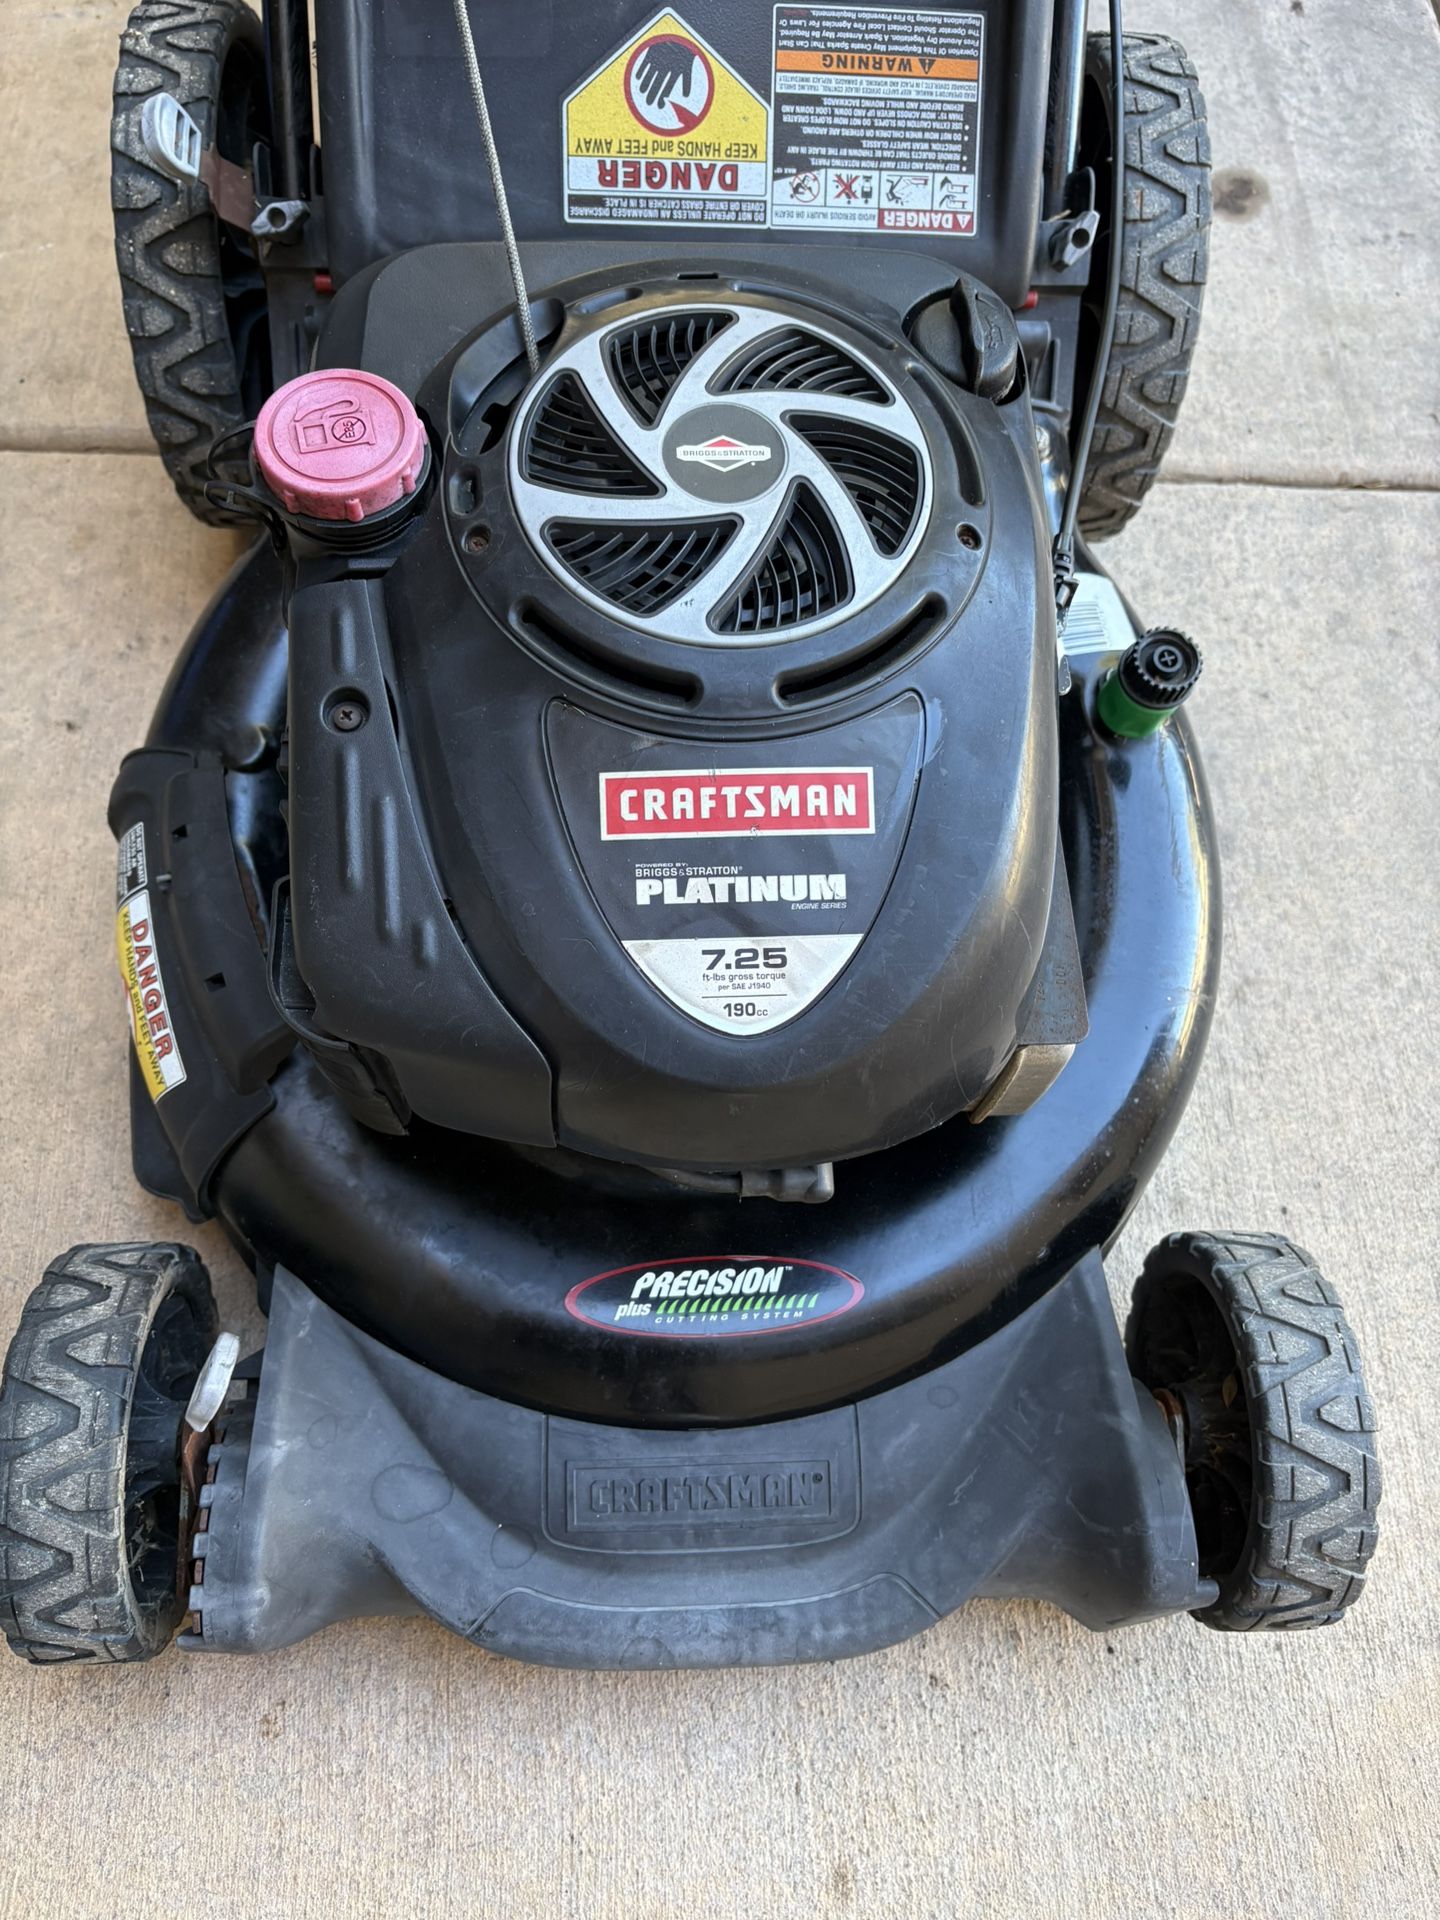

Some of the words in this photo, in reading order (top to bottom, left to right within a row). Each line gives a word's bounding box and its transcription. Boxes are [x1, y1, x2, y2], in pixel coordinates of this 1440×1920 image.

[810, 9, 856, 19] Requirements.
[857, 13, 892, 21] Prevention
[790, 19, 806, 27] Laws
[916, 15, 942, 24] Relating
[944, 17, 980, 26] Regulations
[822, 20, 851, 29] Agencies
[779, 28, 809, 37] Required.
[822, 30, 835, 38] May
[939, 27, 966, 35] Operator
[864, 32, 882, 41] Spark
[891, 33, 925, 43] Vegetation.
[926, 35, 938, 44] Dry
[779, 39, 794, 47] Start
[796, 40, 809, 48] Can
[827, 41, 849, 49] Sparks
[850, 43, 872, 51] Create
[873, 43, 886, 51] May
[888, 44, 922, 54] Equipment
[948, 47, 978, 56] Operation
[822, 54, 912, 72] WARNING
[862, 100, 885, 108] MOVING
[886, 101, 904, 109] WHILE
[906, 101, 918, 110] AND
[919, 102, 941, 111] BEFORE
[943, 103, 964, 111] BEHIND
[781, 105, 794, 114] AND
[796, 106, 814, 114] DOWN
[816, 107, 831, 115] LOOK
[853, 108, 866, 117] AND
[867, 109, 875, 117] UP
[876, 109, 895, 118] NEVER
[783, 115, 809, 123] GREATER
[897, 110, 920, 119] ACROSS
[921, 111, 936, 120] MOW
[948, 112, 963, 121] THAN
[811, 116, 832, 124] SLOPES
[834, 117, 849, 125] MOW
[850, 117, 861, 126] NOT
[862, 118, 871, 126] DO
[897, 119, 905, 127] ON
[907, 120, 931, 128] CAUTION
[932, 121, 950, 129] EXTRA
[952, 122, 963, 130] USE
[828, 128, 840, 136] ARE
[841, 128, 864, 137] OTHERS
[866, 129, 874, 137] OR
[876, 130, 904, 138] CHILDREN
[906, 131, 922, 139] WHEN
[924, 132, 939, 140] MOW
[940, 132, 952, 140] NOT
[953, 133, 962, 141] DO
[575, 137, 612, 154] AWAY
[616, 139, 648, 155] FEET
[652, 140, 673, 156] and
[677, 141, 720, 157] HANDS
[725, 142, 757, 158] KEEP
[787, 146, 799, 154] ANY
[890, 141, 911, 150] SAFETY
[912, 142, 929, 150] WEAR
[800, 146, 806, 155] IN
[808, 147, 826, 155] BLADE
[827, 147, 838, 156] THE
[840, 148, 847, 156] BY
[848, 148, 873, 157] THROWN
[875, 149, 882, 157] BE
[883, 150, 895, 158] CAN
[896, 150, 910, 159] THAT
[912, 151, 936, 160] OBJECTS
[937, 152, 960, 160] REMOVE
[831, 159, 859, 168] ROTATING
[861, 160, 878, 168] FROM
[880, 161, 896, 169] AWAY
[897, 161, 910, 169] FEET
[912, 162, 924, 170] AND
[925, 162, 944, 171] HANDS
[945, 163, 960, 171] KEEP
[597, 159, 738, 192] DANGER
[602, 197, 627, 207] PLACE.
[629, 198, 637, 207] IN
[639, 199, 646, 208] IS
[648, 199, 680, 209] CATCHER
[681, 200, 703, 209] GRASS
[705, 201, 728, 210] ENTIRE
[729, 202, 740, 211] OR
[741, 202, 765, 211] COVER
[570, 206, 609, 216] DISCHARGE
[612, 208, 658, 218] UNDAMAGED
[660, 209, 671, 218] AN
[672, 210, 702, 219] UNLESS
[703, 211, 736, 220] OPERATE
[775, 210, 794, 218] DEATH
[796, 211, 805, 219] OR
[807, 211, 828, 219] INJURY
[737, 212, 752, 221] NOT
[754, 212, 764, 221] DO
[830, 212, 856, 220] SERIOUS
[884, 211, 953, 228] DANGER
[343, 420, 356, 439] E85
[620, 784, 857, 821] CRAFTSMAN
[636, 874, 847, 905] PLATINUM
[123, 911, 132, 944] KEEP
[701, 947, 787, 970] 7.25
[125, 946, 137, 990] HANDS
[702, 972, 725, 981] ft-lbs
[729, 974, 753, 983] gross
[757, 972, 785, 980] torque
[131, 919, 173, 1059] DANGER
[134, 990, 142, 1013] and
[139, 1012, 151, 1046] FEET
[149, 1051, 166, 1086] AWAY
[614, 1301, 651, 1320] plus
[655, 1314, 729, 1323] CUTTING
[741, 1310, 803, 1320] SYSTEM
